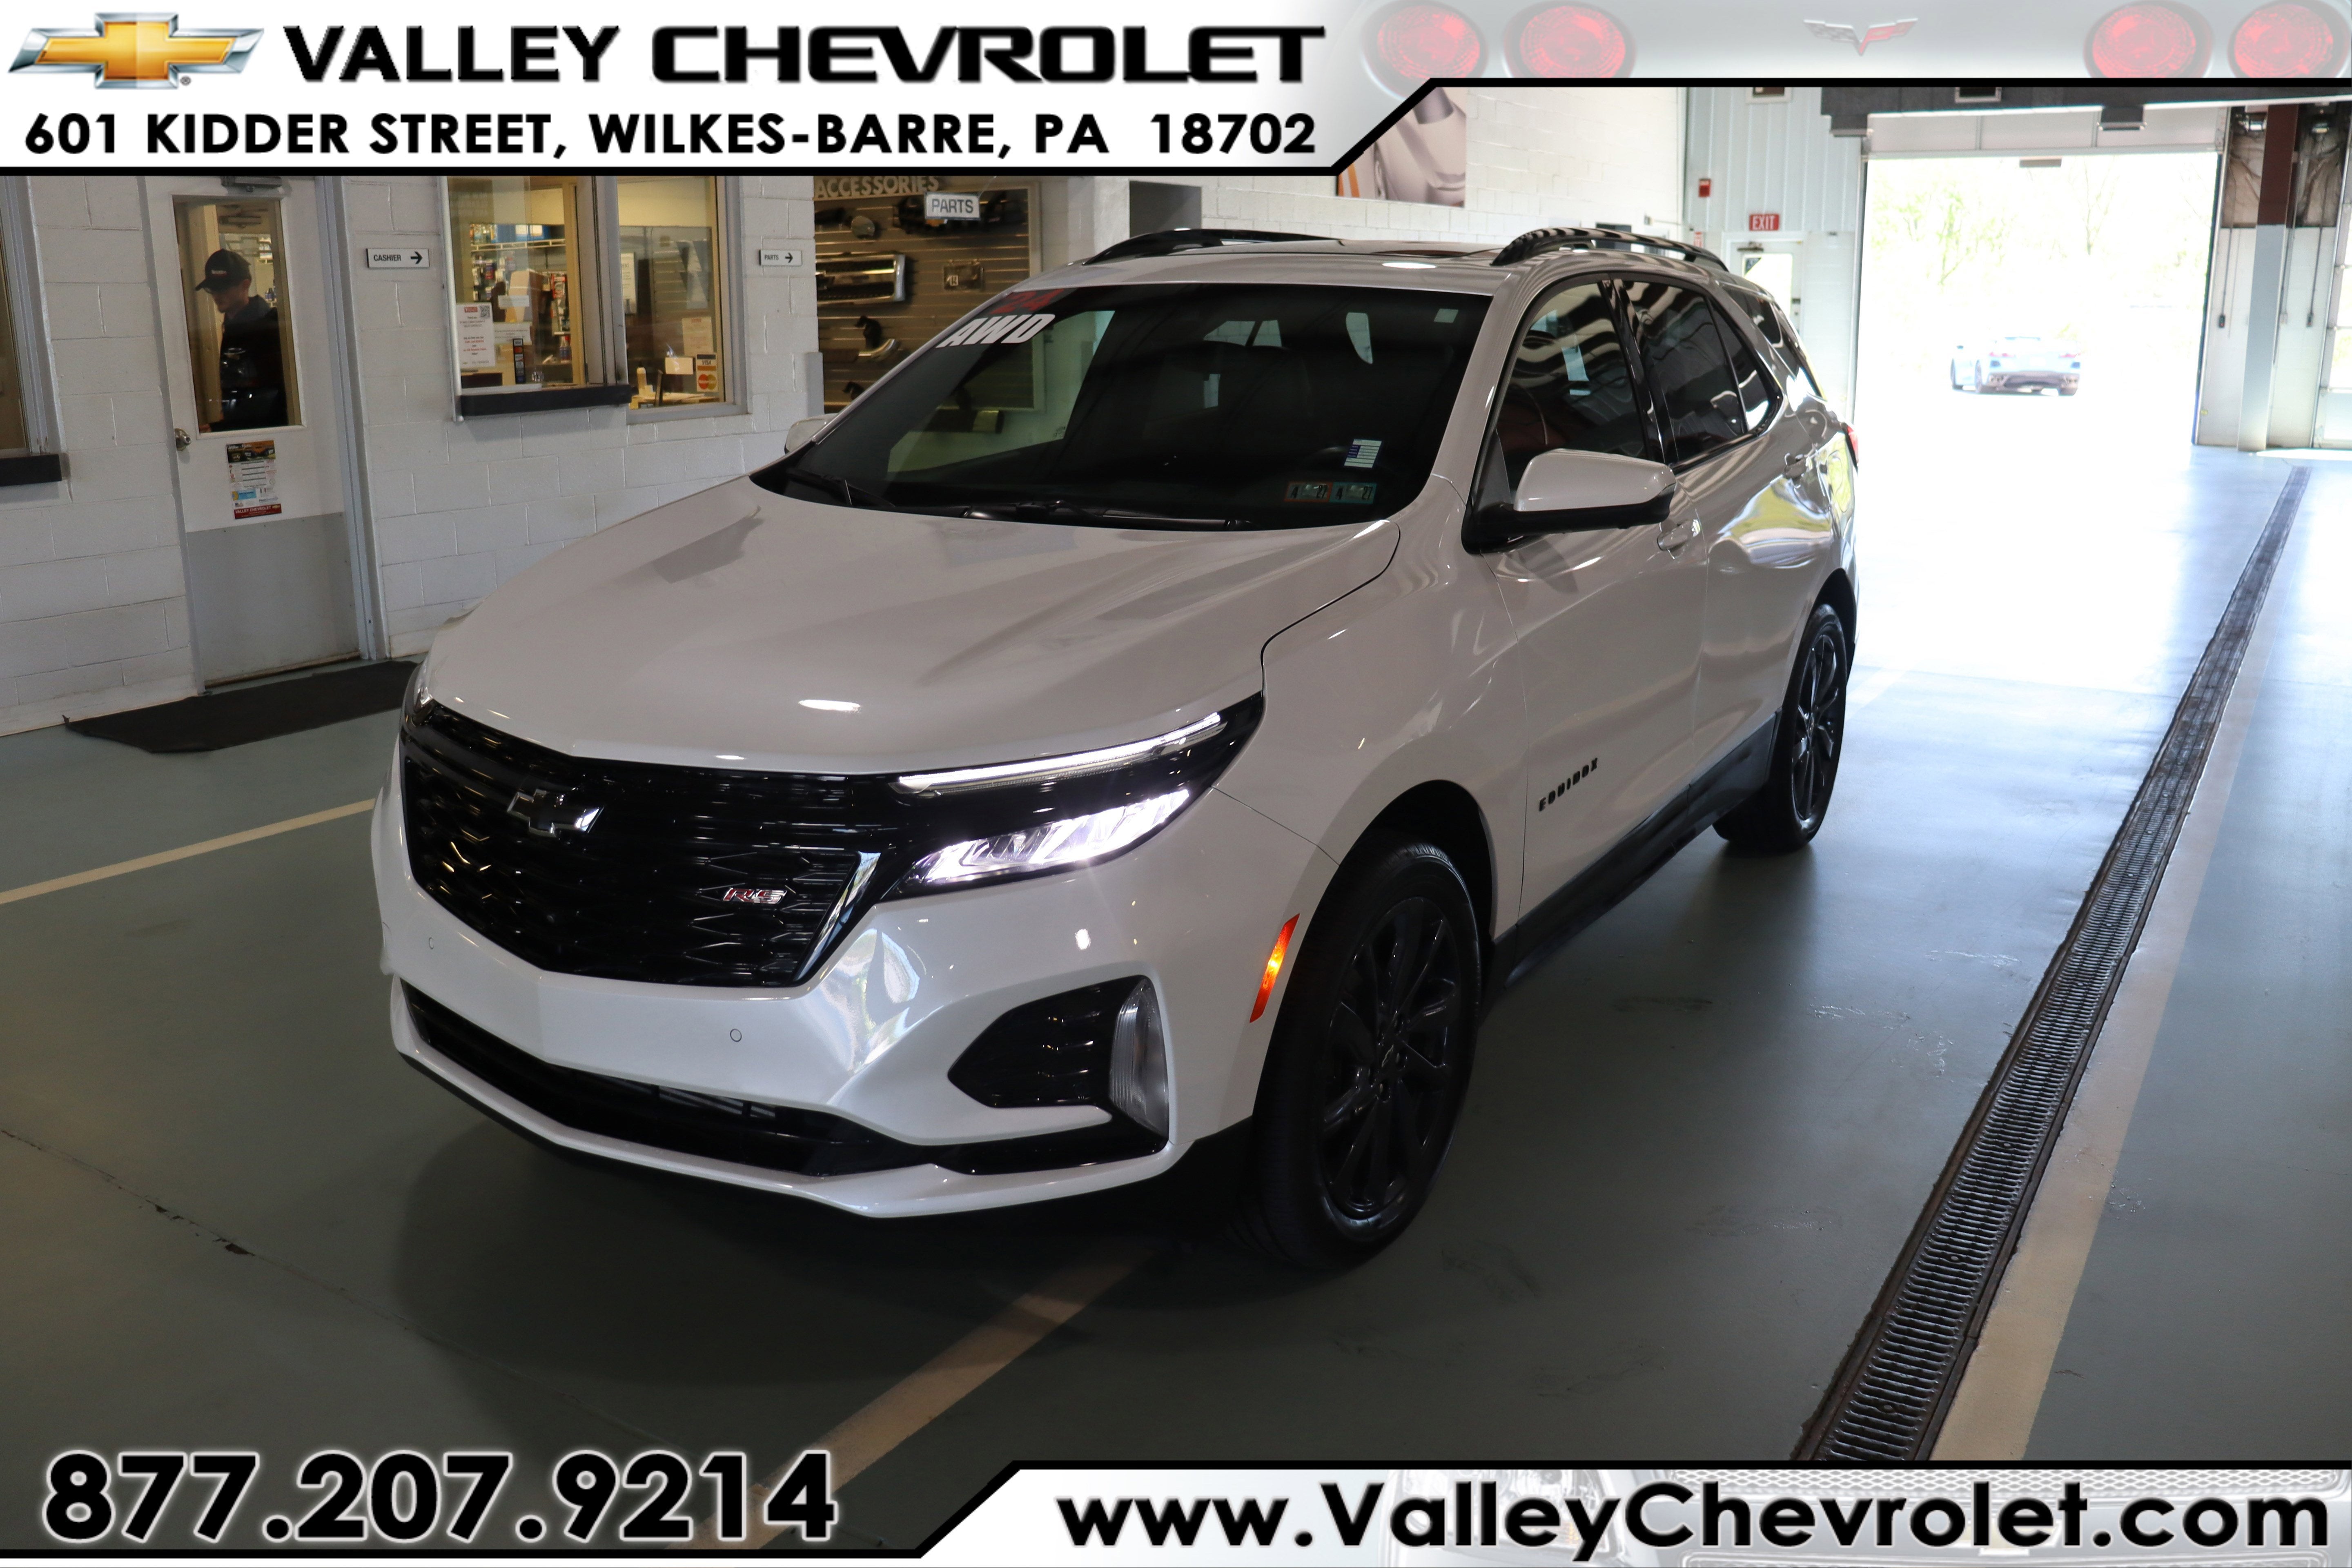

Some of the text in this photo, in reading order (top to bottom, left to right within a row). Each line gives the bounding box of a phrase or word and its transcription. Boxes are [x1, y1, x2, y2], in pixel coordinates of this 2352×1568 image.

[815, 176, 939, 198] ACCESSORIES
[931, 198, 974, 214] PARTS
[1752, 215, 1775, 230] EXIT
[935, 314, 1056, 348] AWD
[1361, 486, 1373, 501] 27
[1539, 757, 1598, 812] EQUINOX
[722, 887, 788, 904] RS
